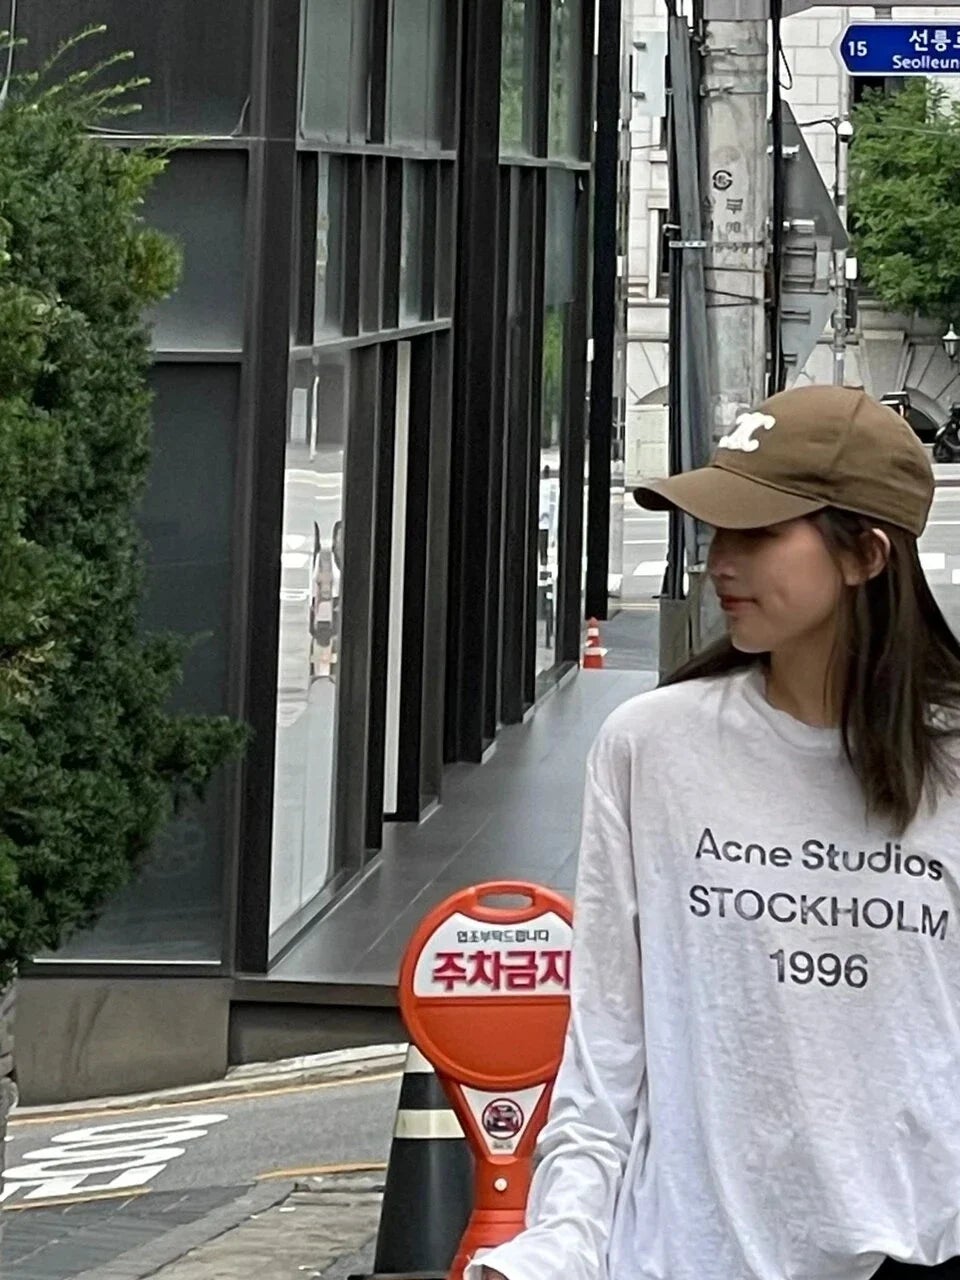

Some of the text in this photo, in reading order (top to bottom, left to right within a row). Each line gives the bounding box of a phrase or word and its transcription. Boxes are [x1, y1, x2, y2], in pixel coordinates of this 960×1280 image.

[848, 41, 868, 57] 15
[695, 827, 944, 881] Acne Studios
[689, 884, 949, 941] STOCKHOLM
[432, 950, 571, 991] 주차금지
[770, 948, 869, 989] 1996
